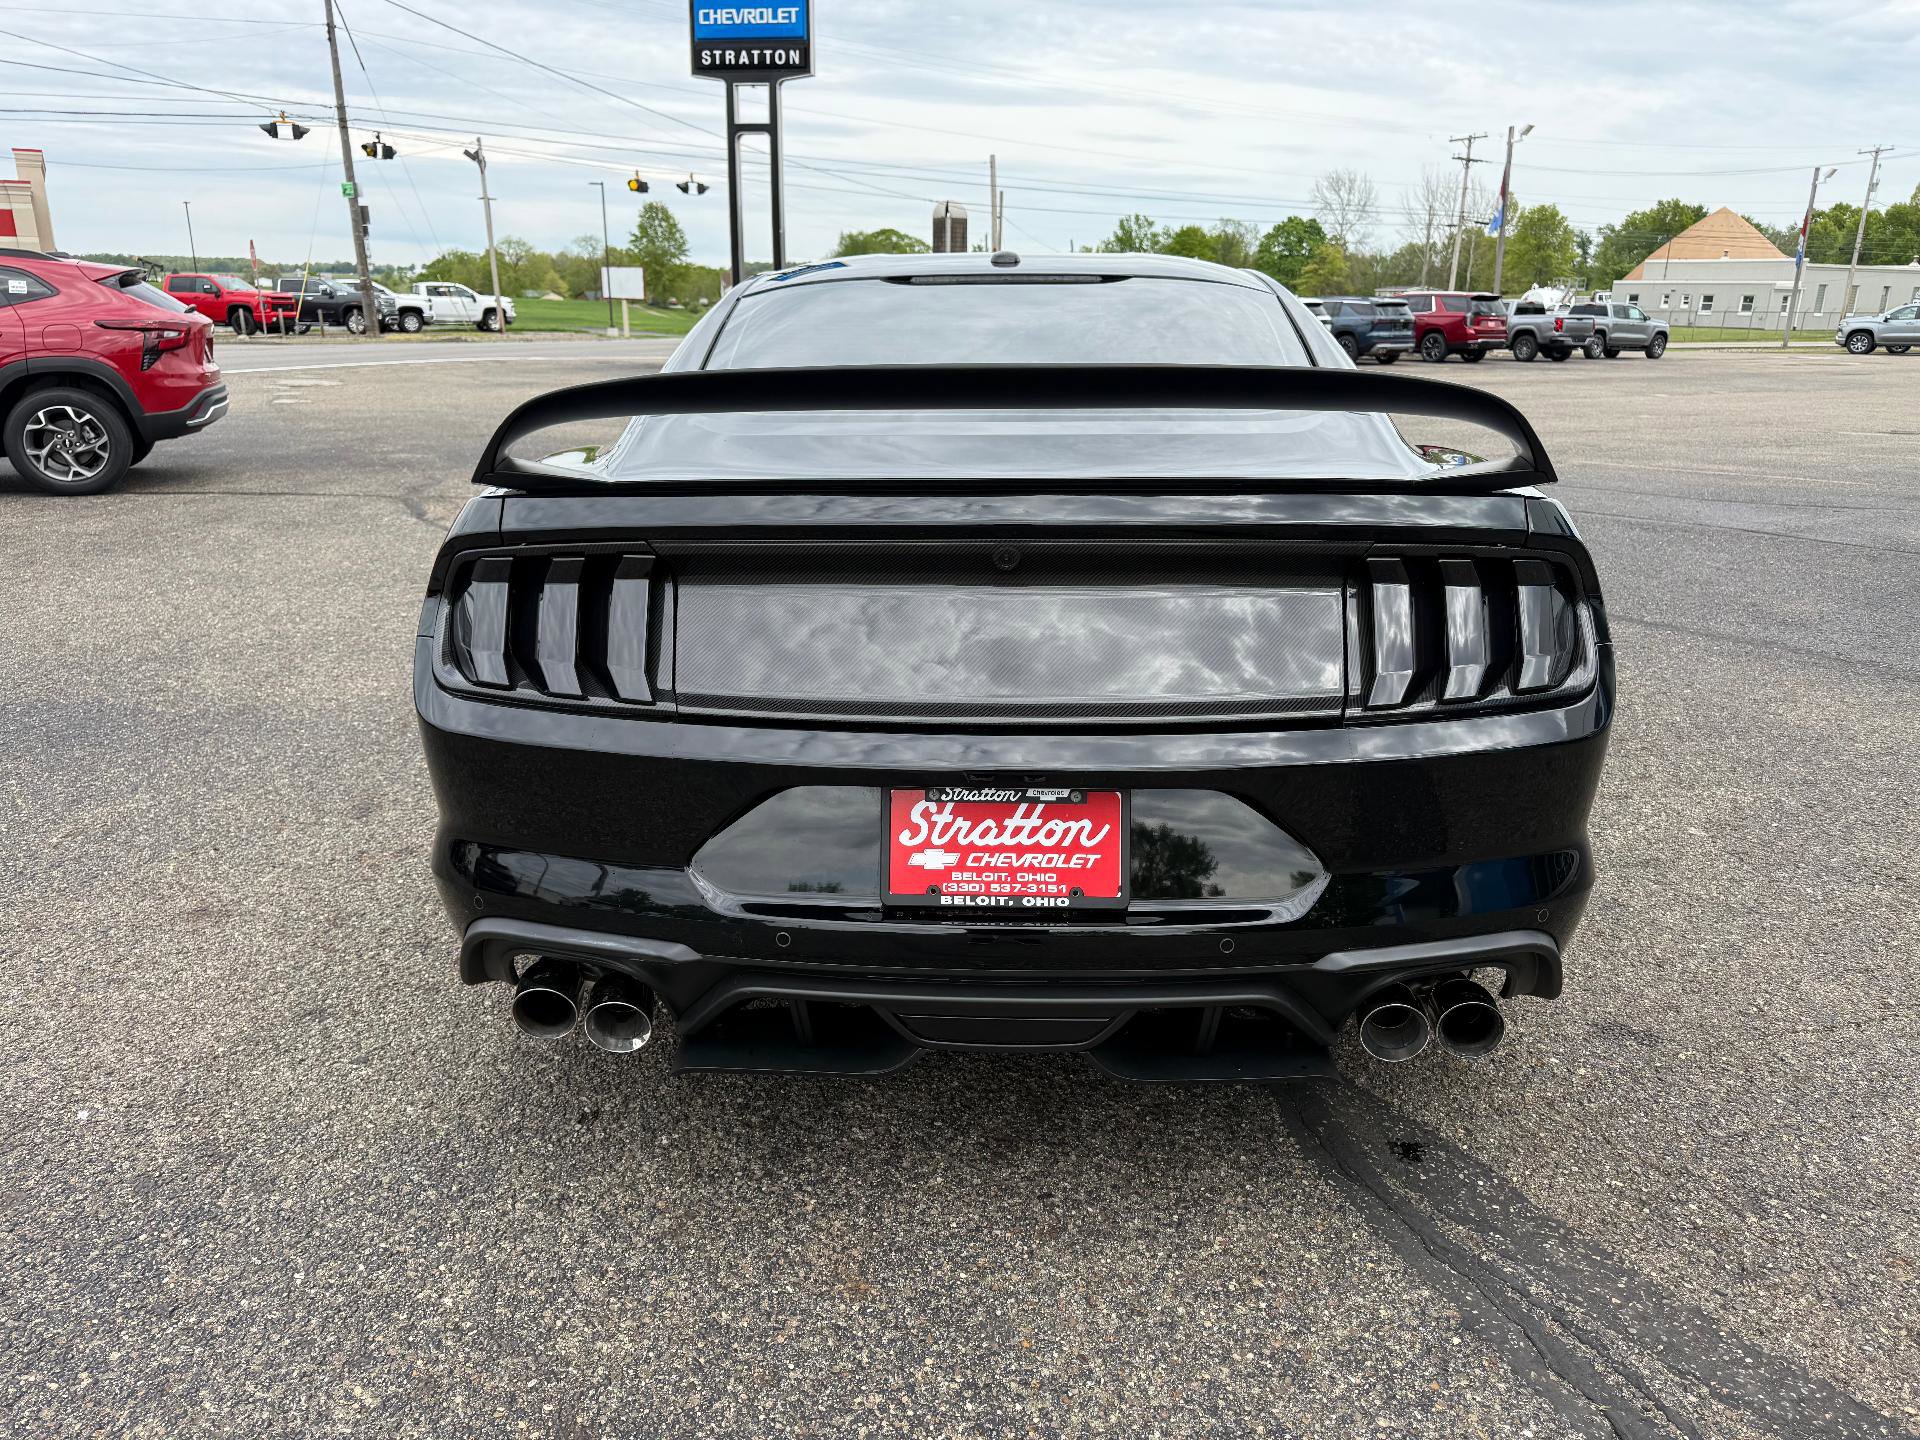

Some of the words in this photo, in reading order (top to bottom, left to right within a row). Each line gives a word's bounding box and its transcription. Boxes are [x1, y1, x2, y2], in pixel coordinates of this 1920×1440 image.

[698, 7, 800, 25] CHEVROLET
[701, 49, 800, 65] STRATTON
[941, 787, 1022, 803] Stratton
[898, 799, 1111, 848] Stratton
[965, 852, 1102, 869] CHEVROLET
[951, 872, 1011, 883] BELOIT,
[1017, 872, 1057, 882] OHIO
[942, 883, 985, 893] (330)
[990, 883, 1067, 894] 537-3151
[940, 896, 1014, 906] BELOIT,
[1021, 896, 1070, 907] OHIO
